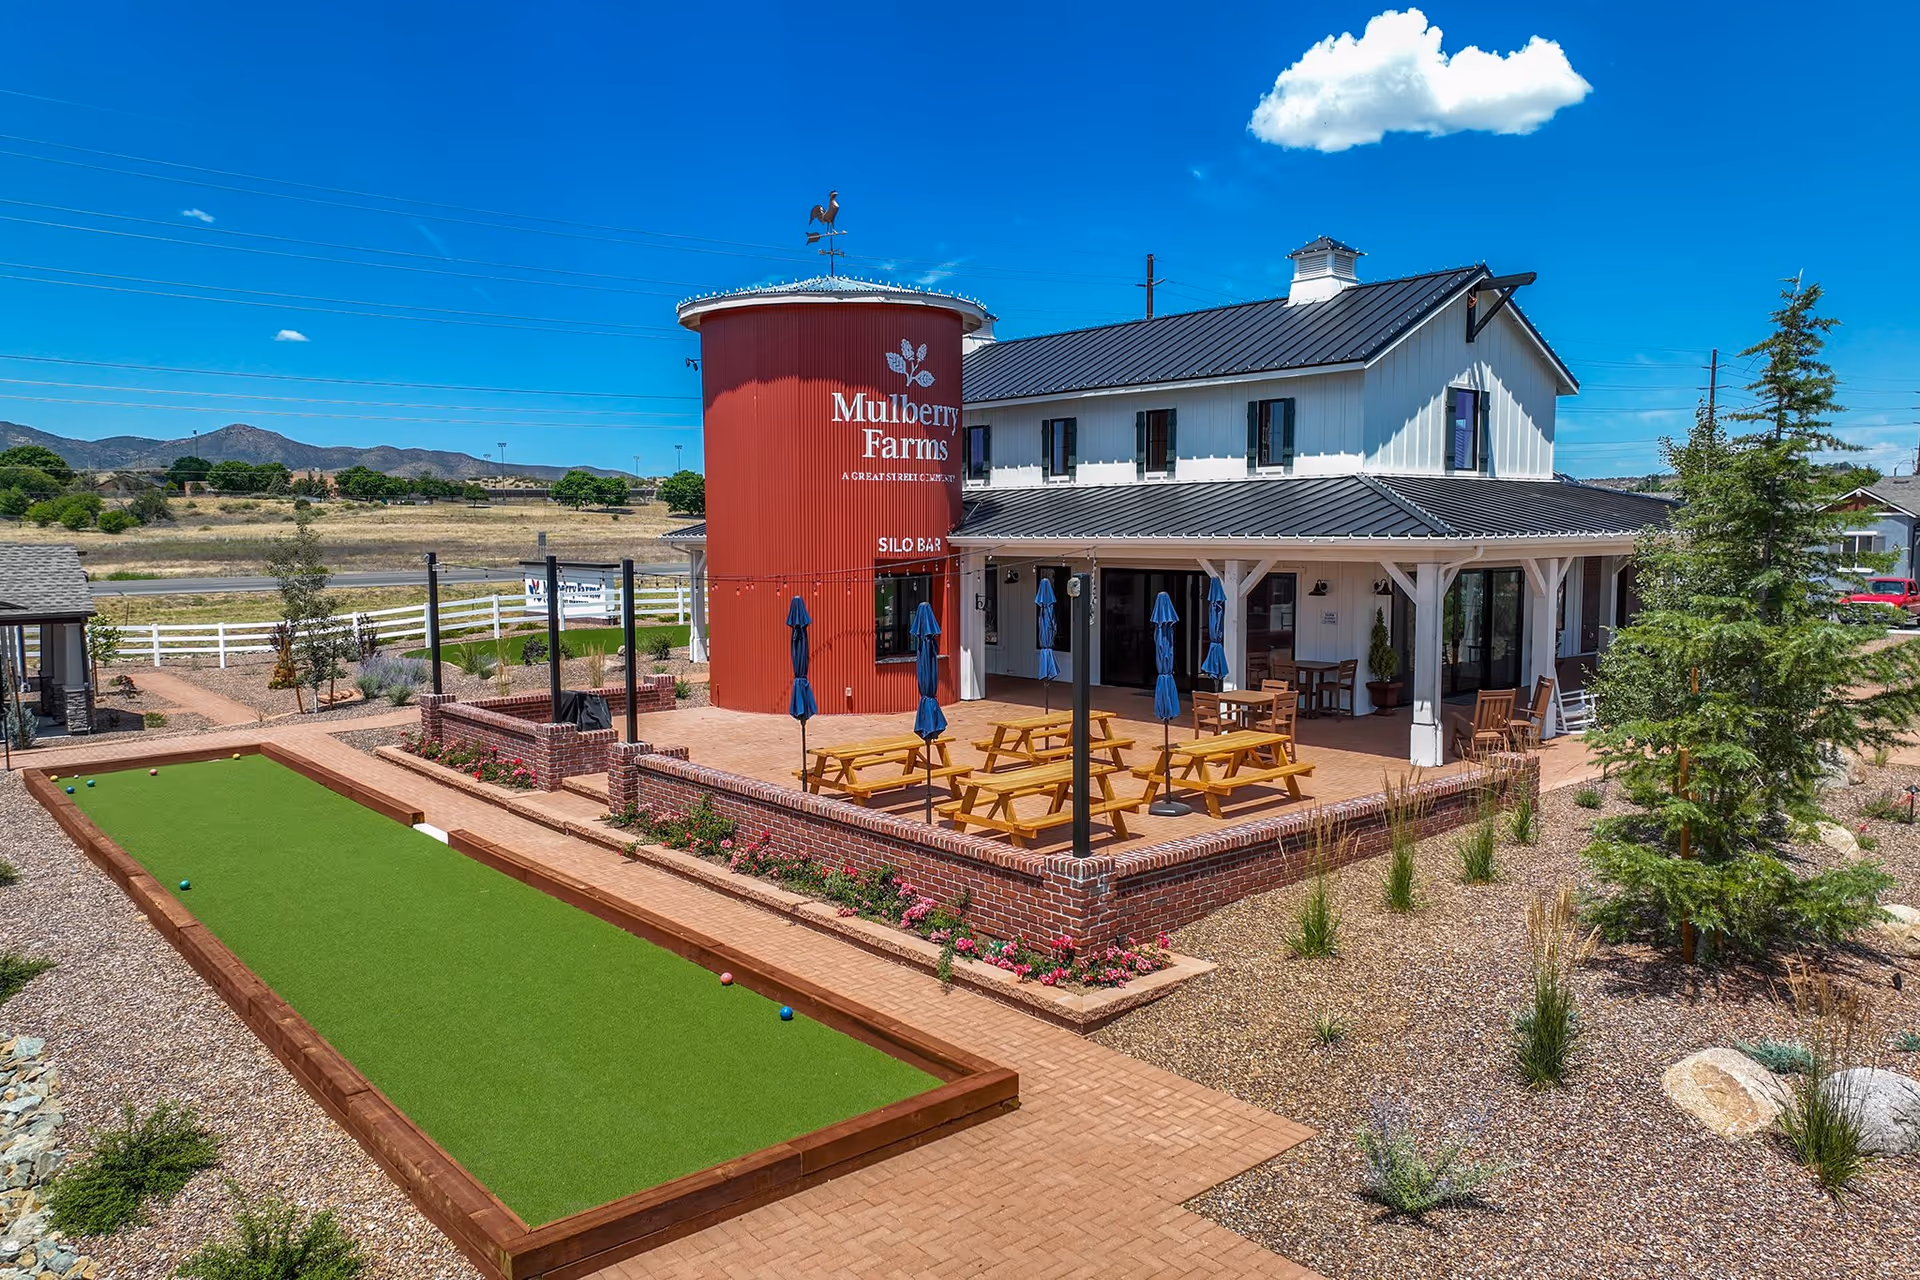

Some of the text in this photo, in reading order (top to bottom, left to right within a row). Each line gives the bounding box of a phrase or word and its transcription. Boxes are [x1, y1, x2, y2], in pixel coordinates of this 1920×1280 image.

[832, 392, 959, 436] Mulberry
[862, 428, 948, 461] Farms
[841, 471, 850, 481] A
[851, 471, 885, 482] GREAT
[886, 472, 918, 482] STREET
[878, 536, 941, 552] SILO BAR
